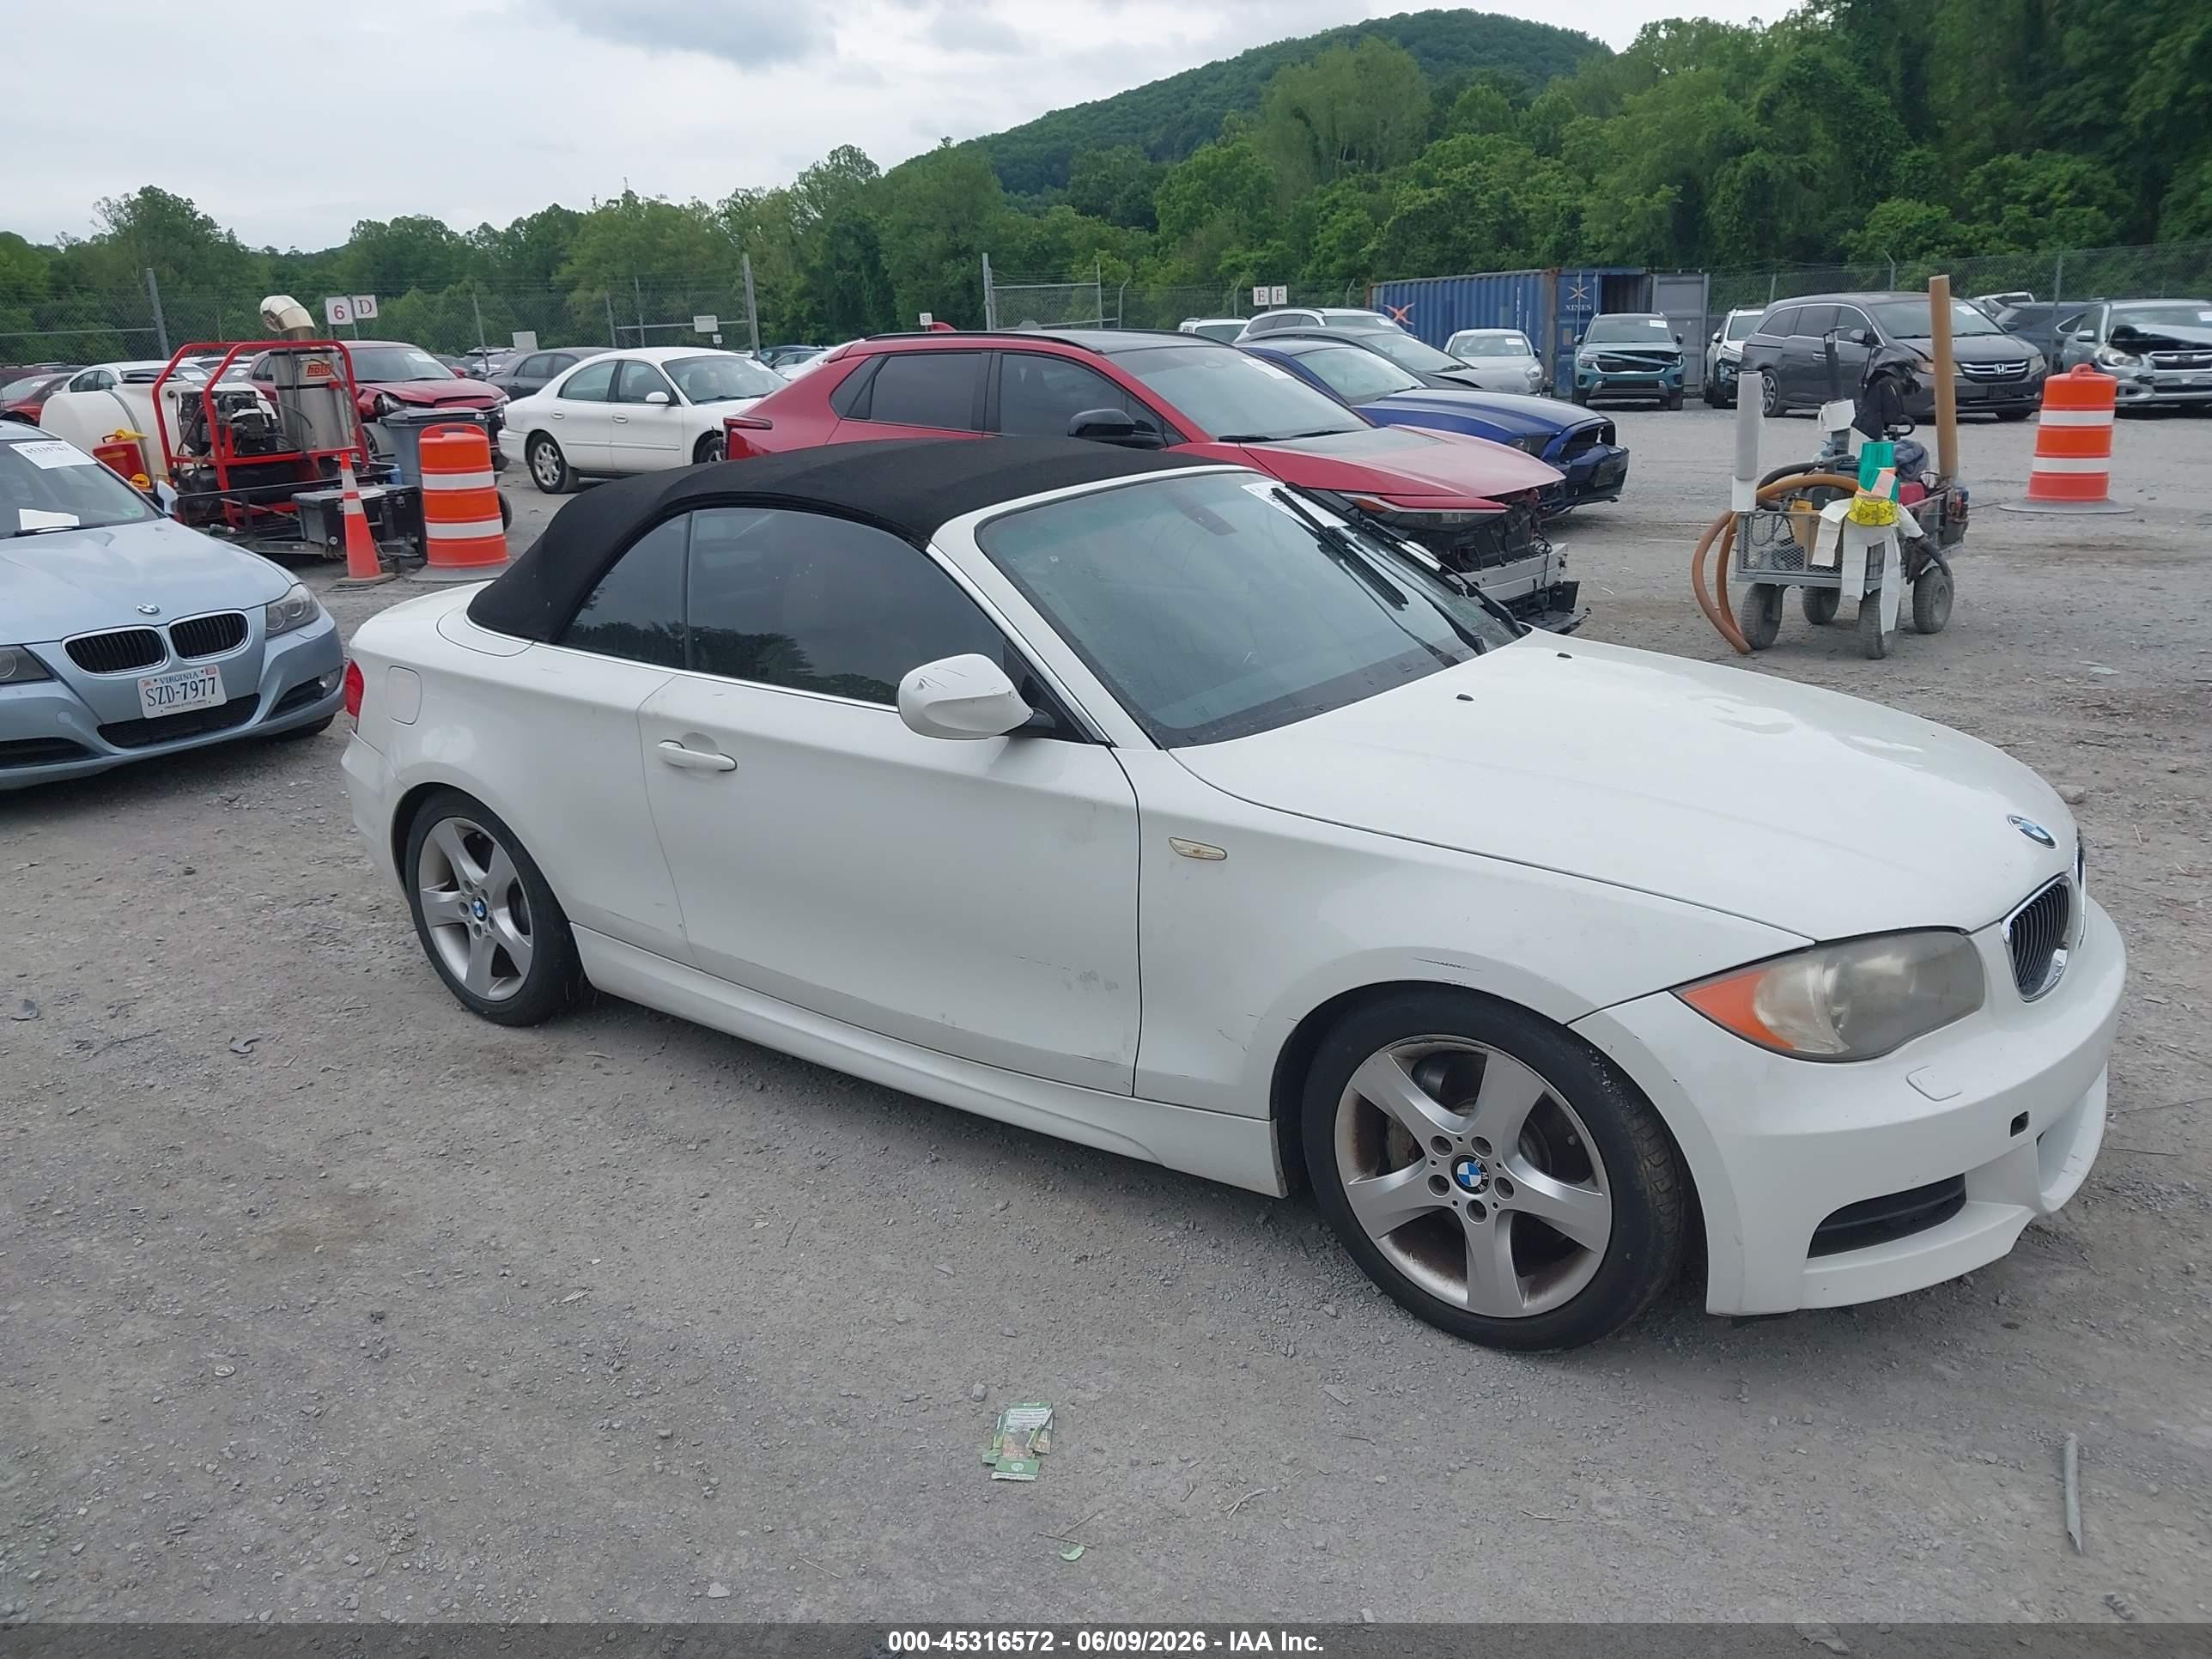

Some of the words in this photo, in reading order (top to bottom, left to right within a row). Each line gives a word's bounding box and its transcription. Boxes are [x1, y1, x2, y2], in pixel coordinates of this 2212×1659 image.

[1257, 289, 1266, 303] E
[1275, 289, 1284, 302] F
[333, 305, 345, 320] 6
[356, 299, 373, 314] D
[159, 671, 200, 685] VIRGINIA
[144, 676, 216, 707] SZD-7977
